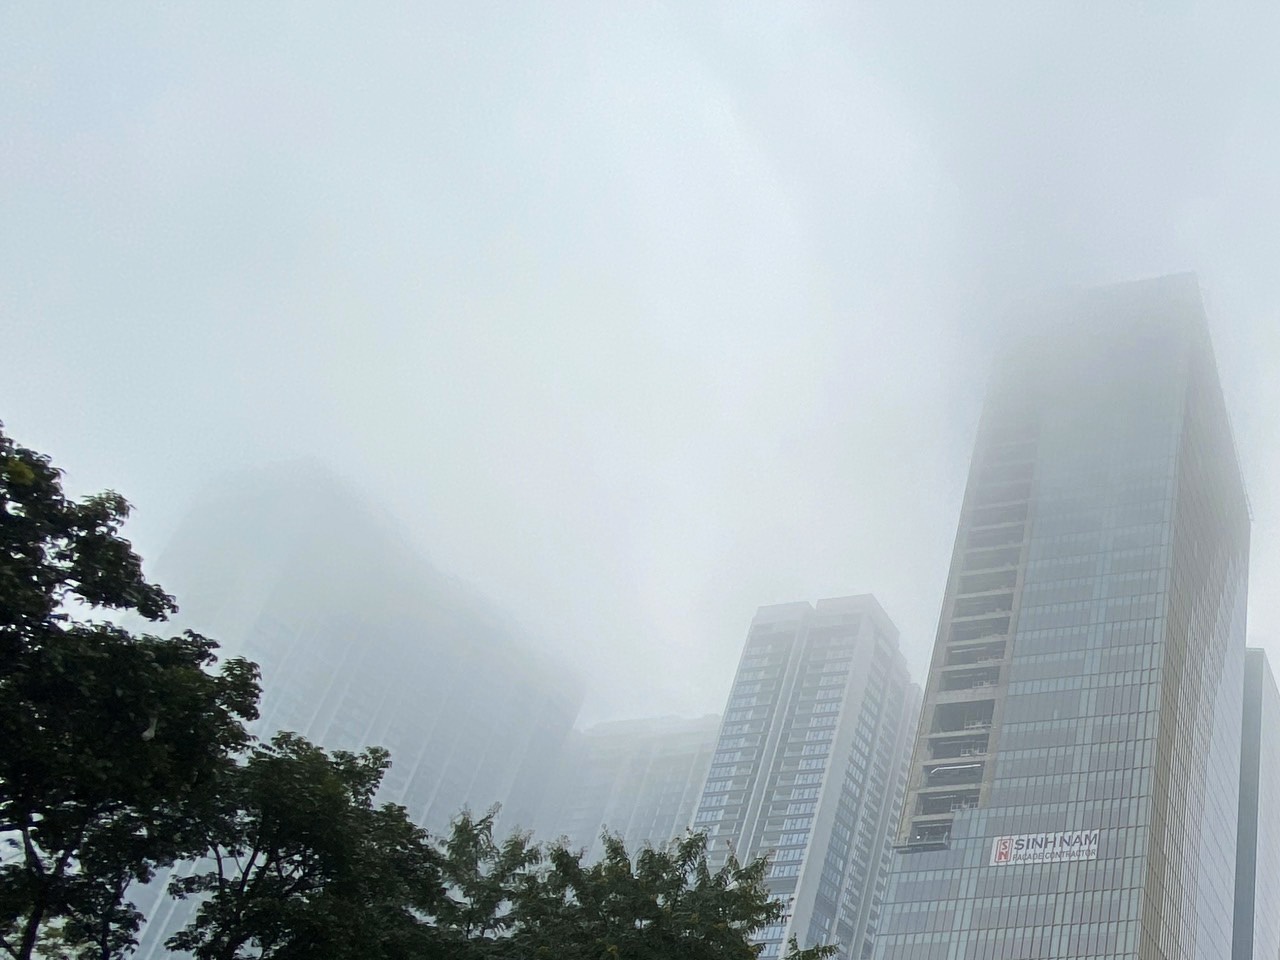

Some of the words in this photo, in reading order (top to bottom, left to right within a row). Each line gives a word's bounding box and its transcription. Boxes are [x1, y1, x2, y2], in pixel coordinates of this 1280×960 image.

[1014, 836, 1056, 851] SINH
[1059, 833, 1098, 848] NAM
[1044, 848, 1097, 860] CONTRACTOR
